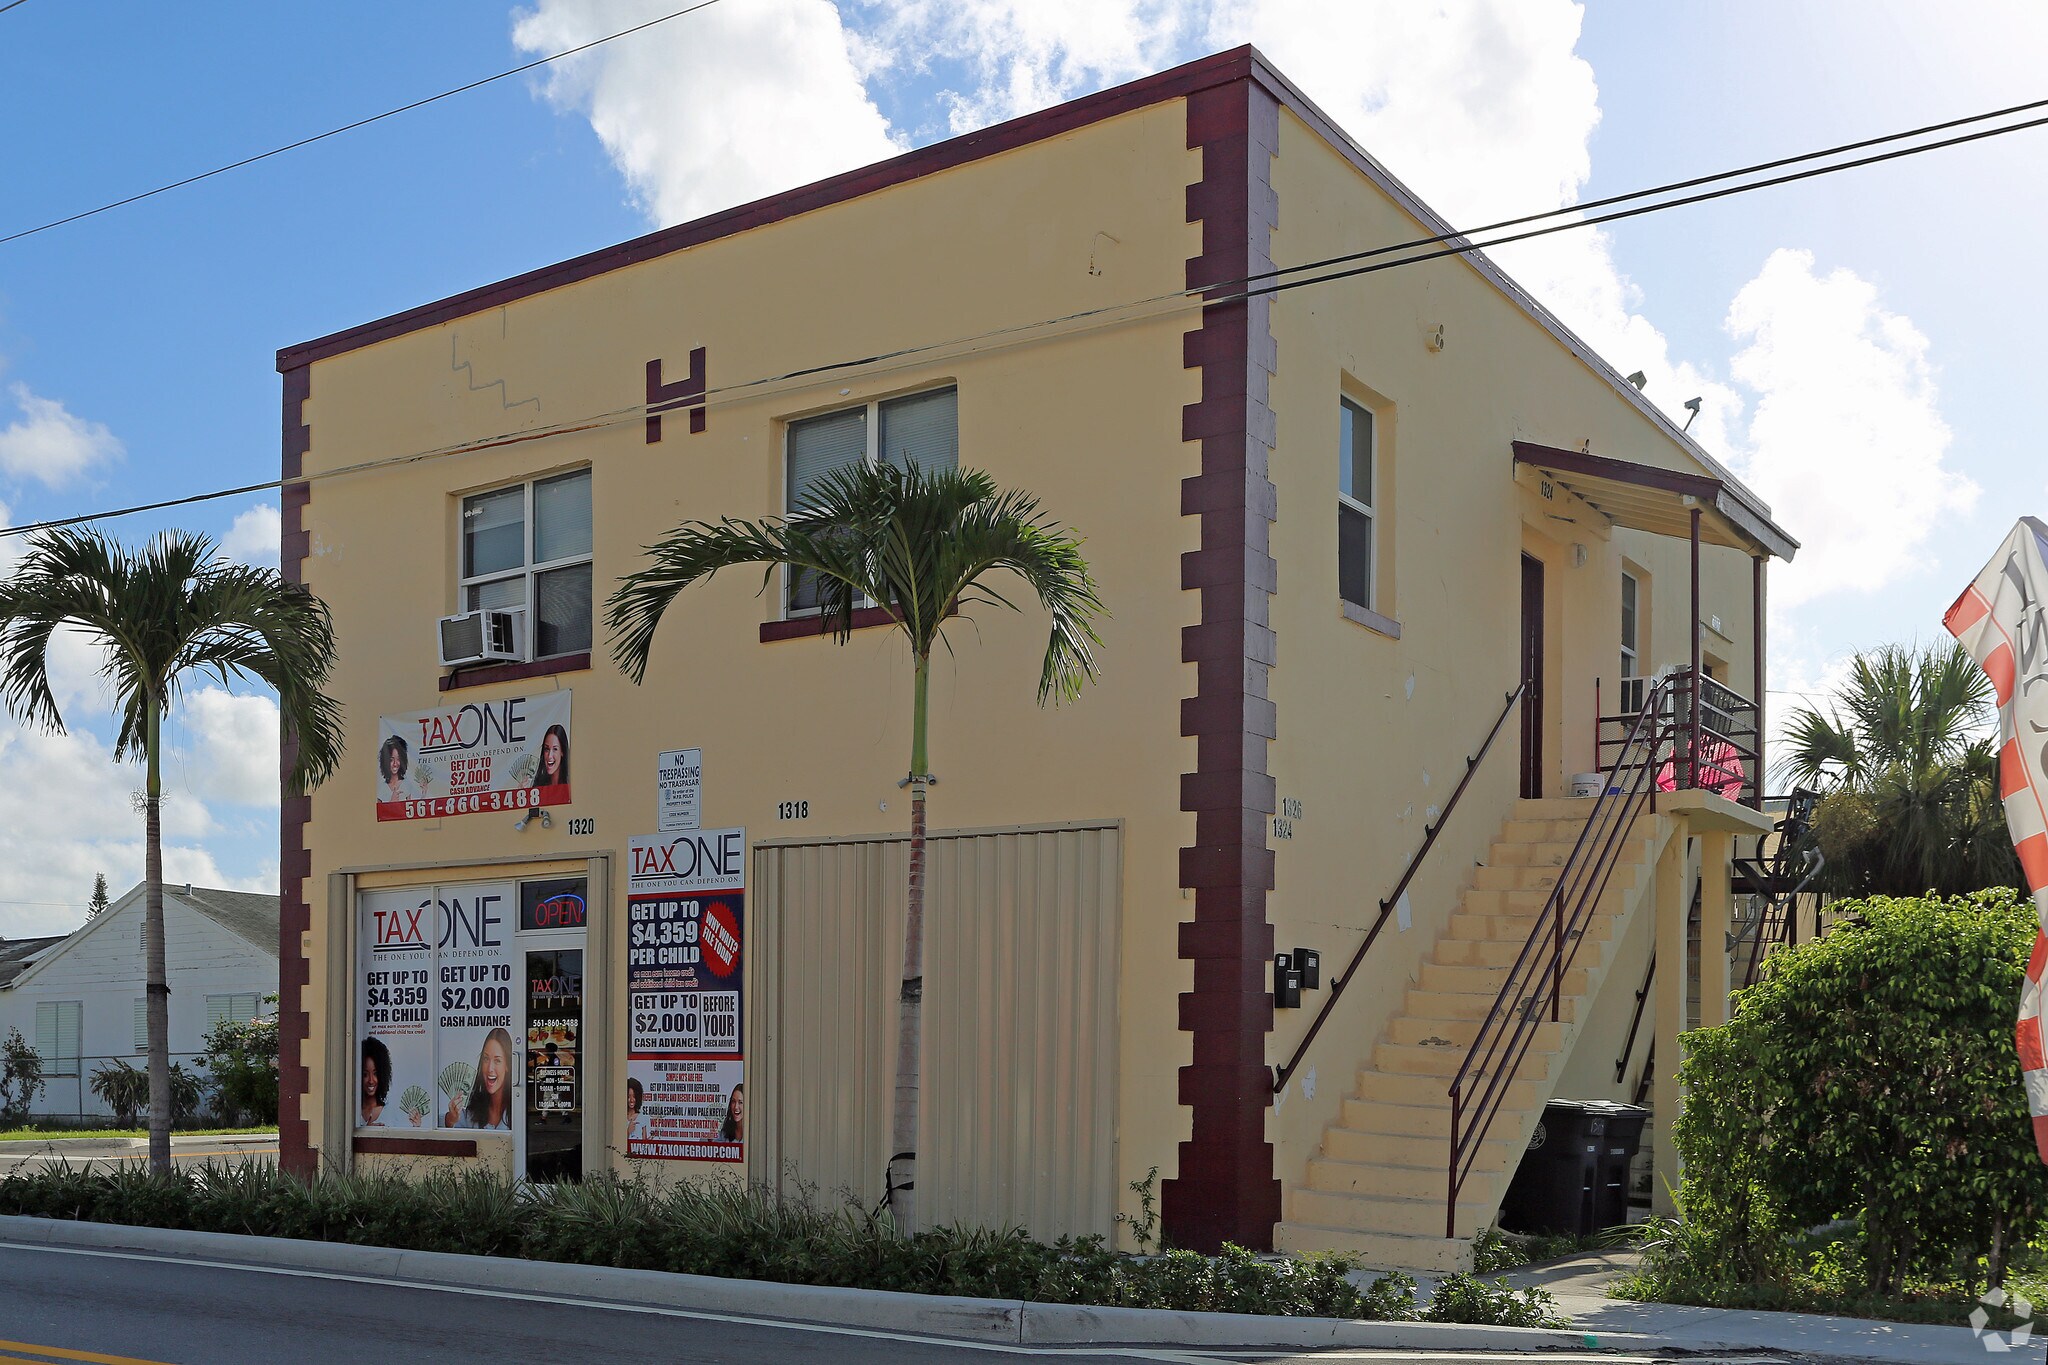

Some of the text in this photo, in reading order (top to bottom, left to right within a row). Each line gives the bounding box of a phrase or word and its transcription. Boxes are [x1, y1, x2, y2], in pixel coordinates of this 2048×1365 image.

[484, 748, 511, 756] DEPEND
[674, 754, 684, 766] NO
[450, 757, 492, 772] GET UP TO
[660, 766, 700, 780] TRESPASSING
[450, 769, 491, 787] $2,000
[668, 779, 700, 788] TRASPASAR
[450, 784, 490, 796] CASH ADVANCE
[406, 788, 540, 818] 561-860-3488
[778, 800, 808, 820] 1318
[568, 818, 594, 836] 1320
[1273, 818, 1292, 838] 1324
[535, 901, 582, 926] OPEN
[632, 900, 700, 920] GET UP TO
[632, 921, 698, 946] $4,359
[706, 910, 739, 954] WHY WAIT?
[452, 950, 483, 958] DEPEND
[702, 926, 733, 966] FILE TODAY
[630, 946, 700, 965] PER CHILD
[368, 970, 428, 986] GET UP TO
[441, 964, 510, 983] GET UP TO
[368, 986, 427, 1007] $4,359
[442, 986, 509, 1011] $2,000
[635, 994, 698, 1009] GET UP TO
[704, 996, 734, 1012] BEFORE
[366, 1008, 429, 1022] PER CHILD
[440, 1016, 510, 1027] CASH ADVANCE
[636, 1013, 697, 1034] $2,000
[704, 1015, 734, 1036] YOUR
[634, 1038, 698, 1048] CASH ADVANCE
[642, 1106, 648, 1115] SE
[649, 1106, 663, 1116] HABLA
[664, 1105, 683, 1116] ESPAÑOL
[687, 1107, 697, 1116] NOU
[698, 1107, 708, 1116] PALE
[650, 1119, 718, 1129] WE PROVIDE TRANSPORTATION
[631, 1143, 740, 1159] WWW.TAXONEGROUP.COM
